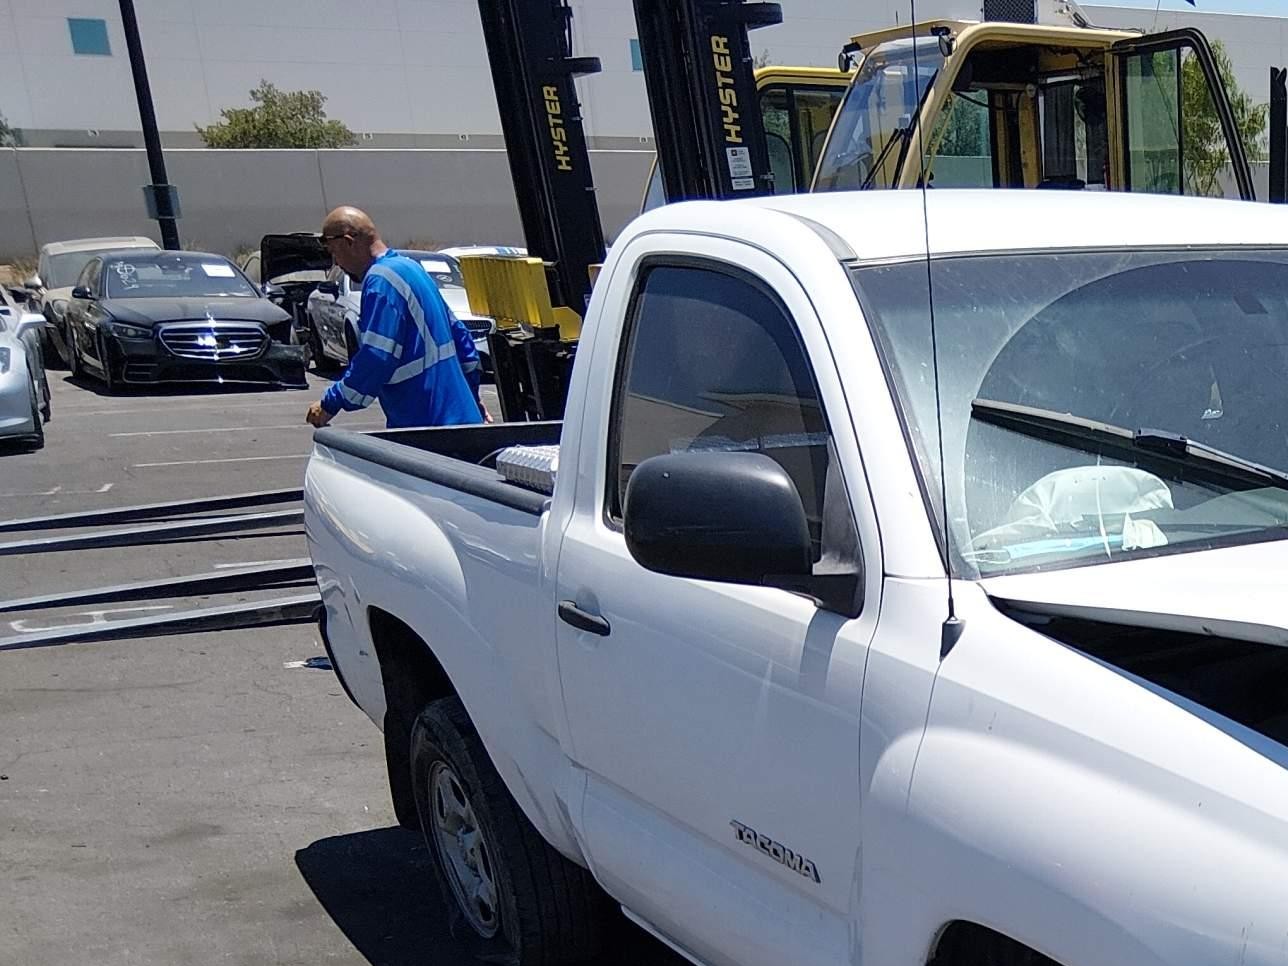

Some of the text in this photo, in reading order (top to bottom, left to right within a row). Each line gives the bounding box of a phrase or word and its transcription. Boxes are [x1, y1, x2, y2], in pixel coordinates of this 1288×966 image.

[542, 86, 572, 171] HYSTER
[711, 35, 742, 143] HYSTER
[729, 819, 821, 883] TACOMA
